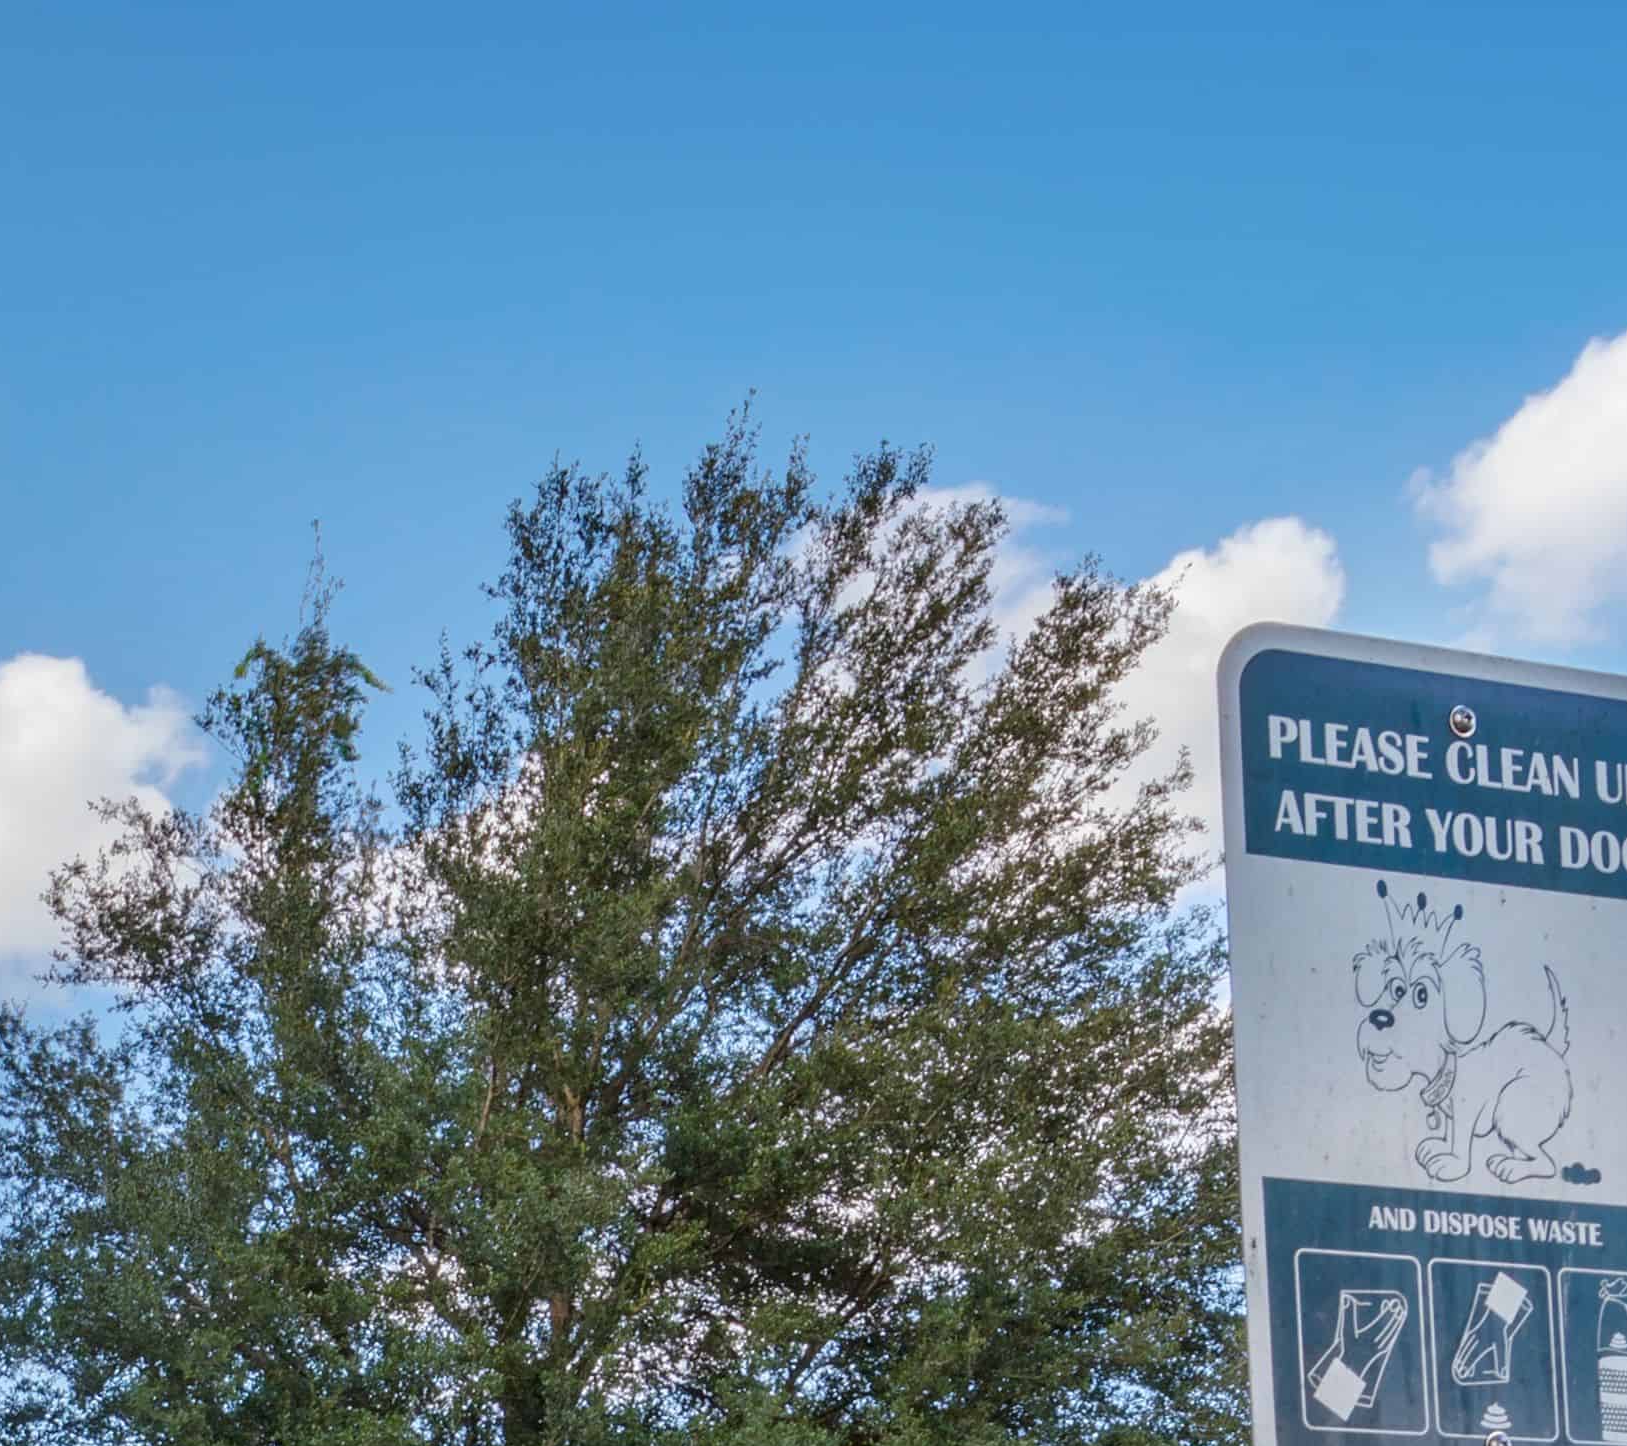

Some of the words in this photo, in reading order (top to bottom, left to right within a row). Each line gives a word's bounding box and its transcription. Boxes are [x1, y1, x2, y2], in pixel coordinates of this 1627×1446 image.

[1268, 714, 1433, 779] PLEASE
[1446, 741, 1580, 799] CLEAN
[1274, 789, 1413, 848] AFTER
[1425, 808, 1545, 865] YOUR
[1368, 1206, 1416, 1232] AND
[1423, 1210, 1522, 1240] DISPOSE
[1528, 1218, 1604, 1246] WASTE
